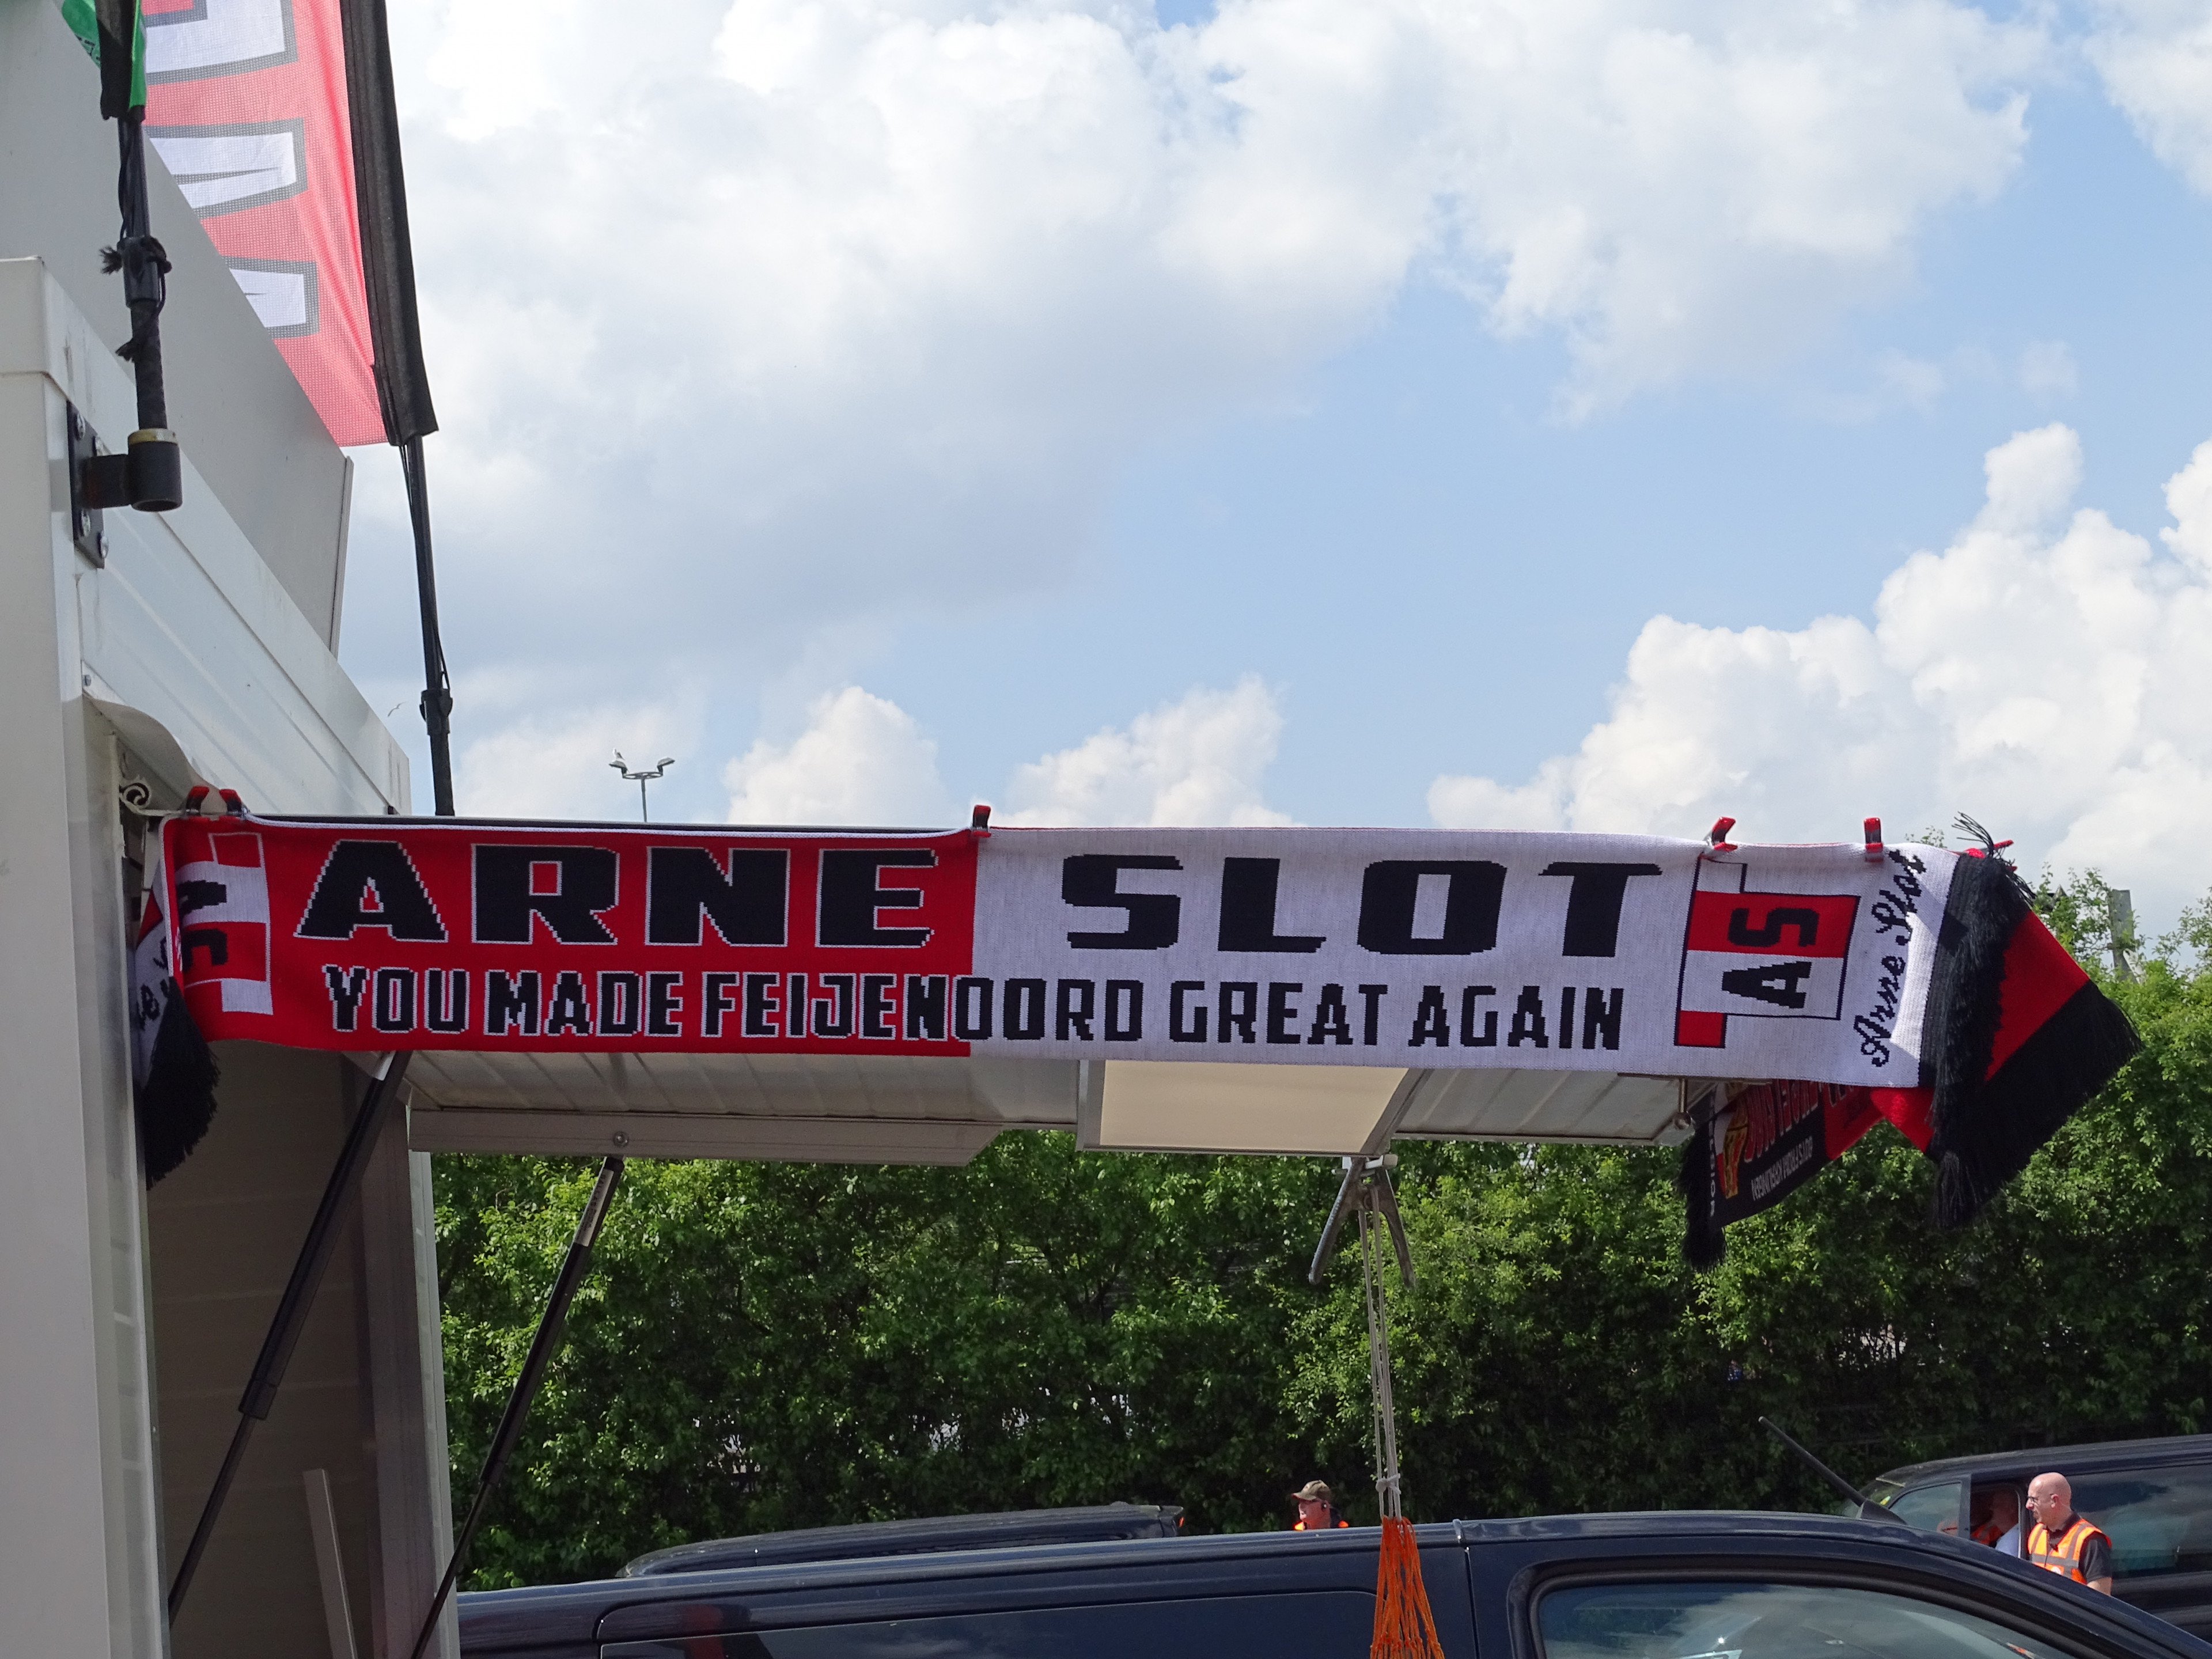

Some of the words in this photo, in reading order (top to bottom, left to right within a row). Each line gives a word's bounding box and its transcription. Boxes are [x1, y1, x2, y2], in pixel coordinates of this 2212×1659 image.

[293, 839, 938, 948] ARNE
[1062, 854, 1663, 957] SLOT
[321, 964, 469, 1034] YOU
[483, 969, 684, 1037] MADE
[701, 971, 1143, 1042] FEIJENOORD
[1169, 980, 1388, 1046] GREAT
[1408, 984, 1624, 1051] AGAIN
[1854, 955, 1906, 1067] Arne
